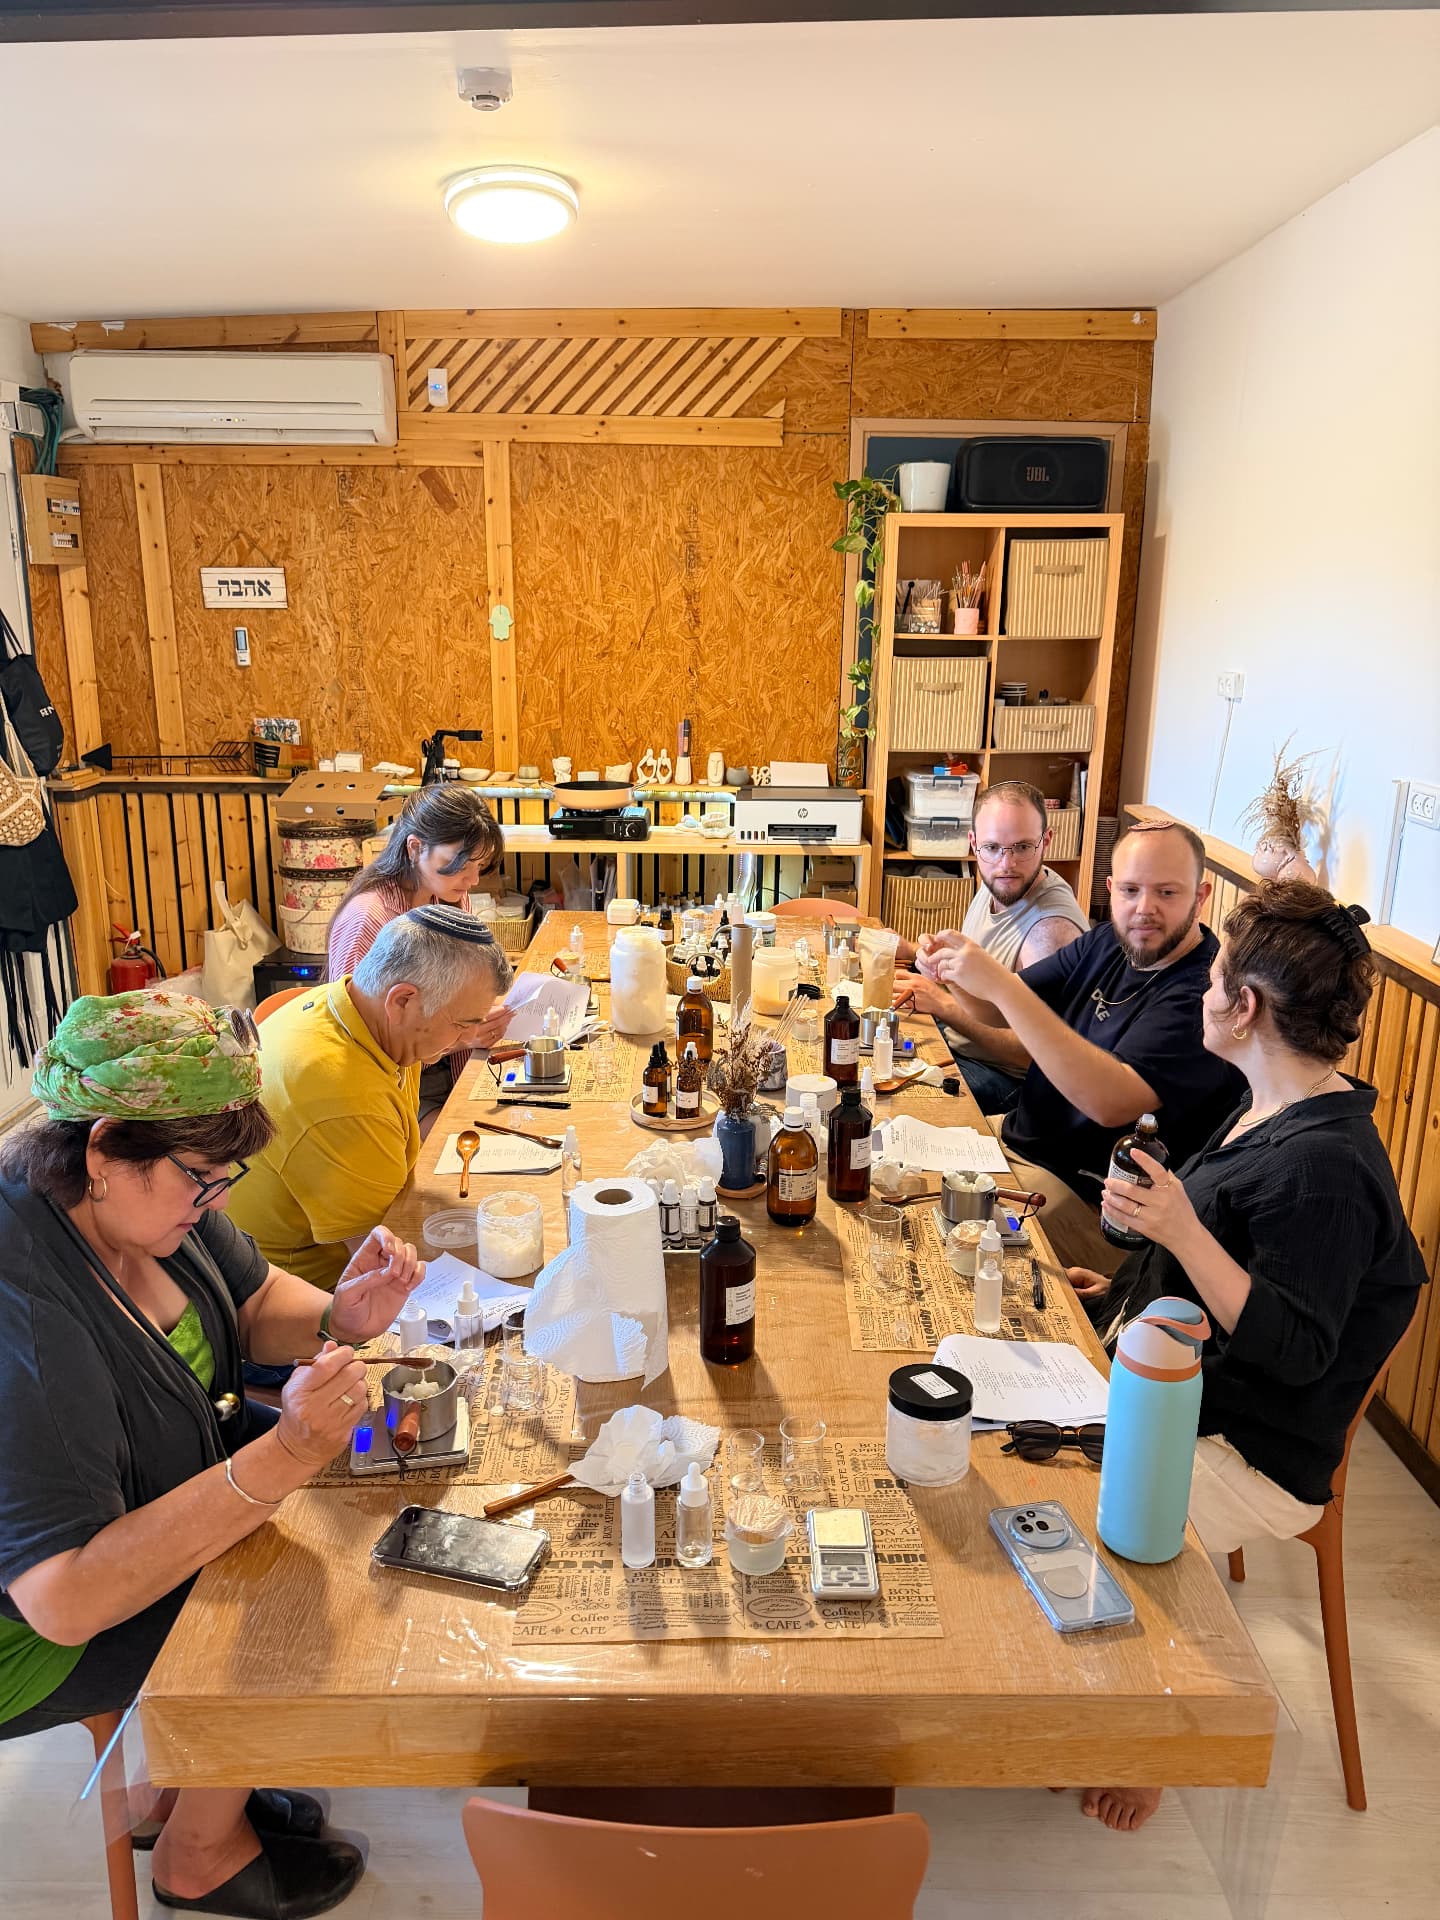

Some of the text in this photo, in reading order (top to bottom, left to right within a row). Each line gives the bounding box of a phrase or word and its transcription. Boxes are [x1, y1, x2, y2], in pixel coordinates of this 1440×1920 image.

[1026, 466, 1050, 482] JBL
[217, 579, 272, 597] אהבה
[797, 808, 809, 819] hp
[1008, 1318, 1028, 1342] BO
[548, 1499, 576, 1511] CAFE
[566, 1519, 600, 1528] Coffee
[822, 1607, 860, 1617] Coffee
[571, 1613, 610, 1622] Coffee
[765, 1620, 802, 1630] CAFE
[824, 1621, 860, 1630] CAFE
[570, 1626, 607, 1635] CAFE
